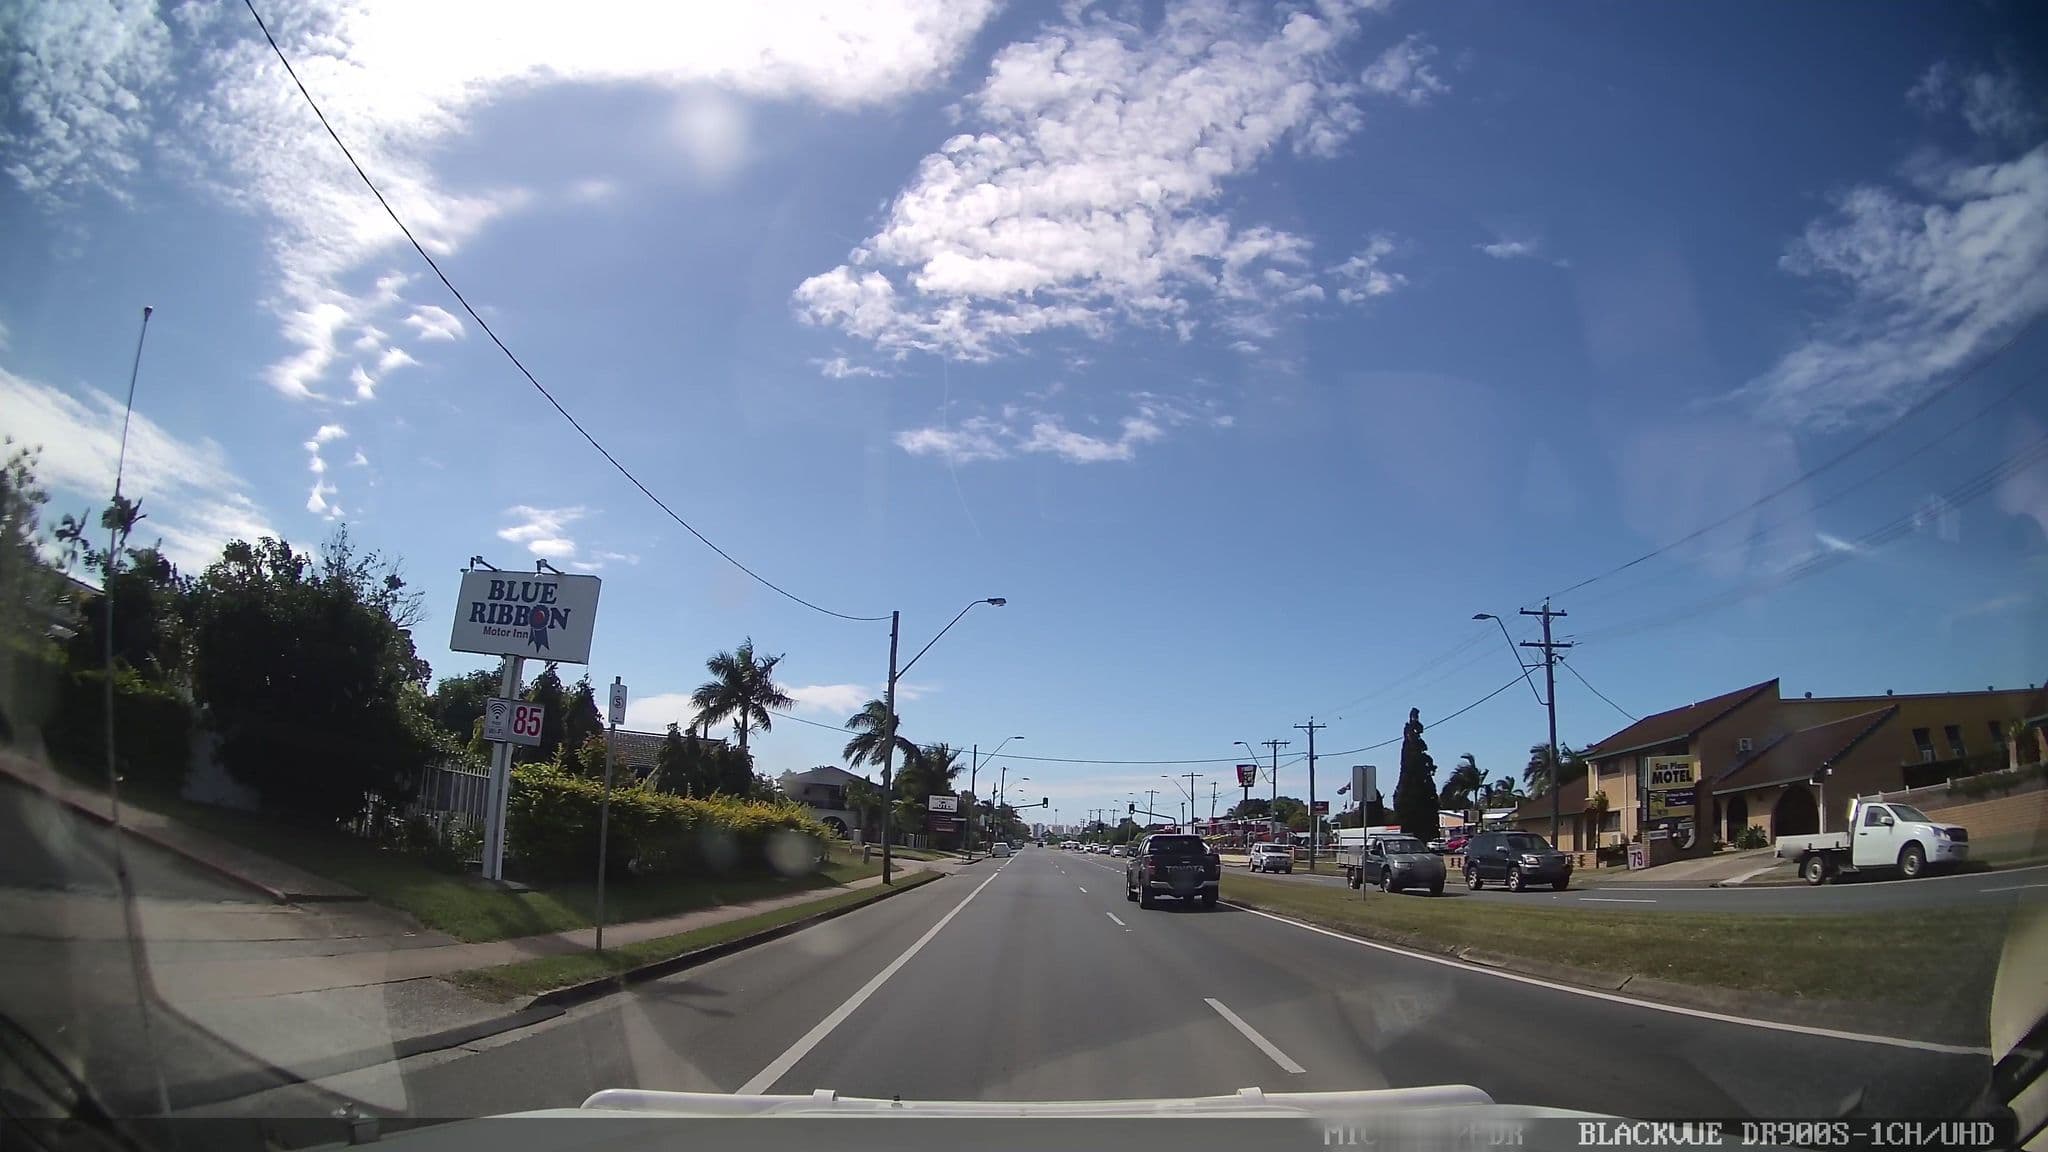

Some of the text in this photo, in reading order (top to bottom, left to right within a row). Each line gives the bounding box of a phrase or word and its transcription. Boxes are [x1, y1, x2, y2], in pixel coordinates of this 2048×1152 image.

[488, 579, 557, 604] BLUE
[469, 602, 571, 630] RIBBON
[482, 625, 529, 639] Motor Inn
[513, 706, 541, 736] 85
[1652, 770, 1692, 784] MOTEL
[1631, 852, 1643, 868] 79
